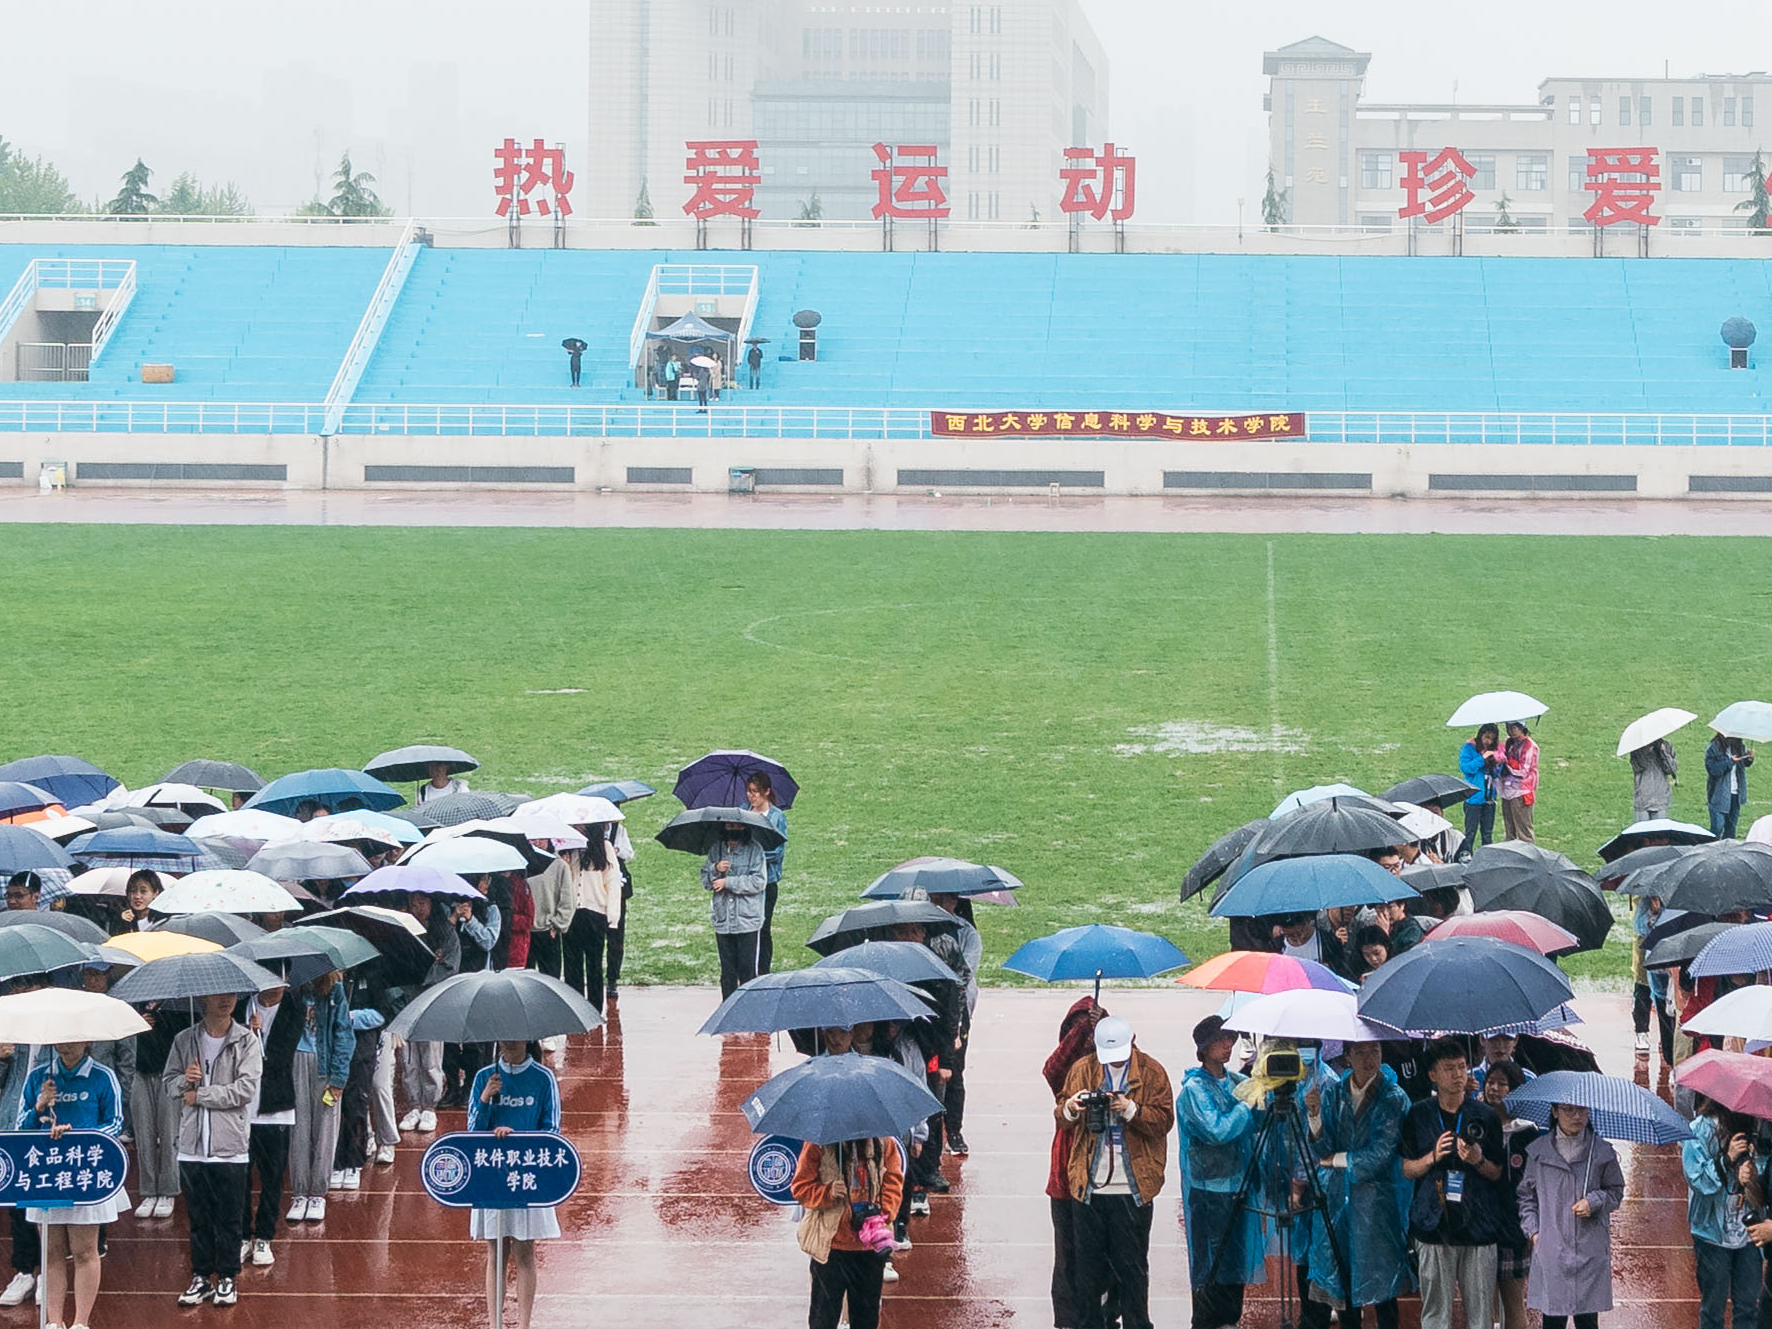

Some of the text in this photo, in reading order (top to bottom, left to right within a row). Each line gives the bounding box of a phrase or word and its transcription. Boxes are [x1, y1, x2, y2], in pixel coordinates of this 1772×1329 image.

[493, 138, 1137, 222] 热爱运动
[944, 412, 1292, 436] 西北大学信息科学与技术学院
[24, 1143, 104, 1168] 食品科学
[473, 1146, 569, 1169] 软件职业技术
[12, 1167, 117, 1194] 与工程学院
[506, 1170, 538, 1192] 学院
